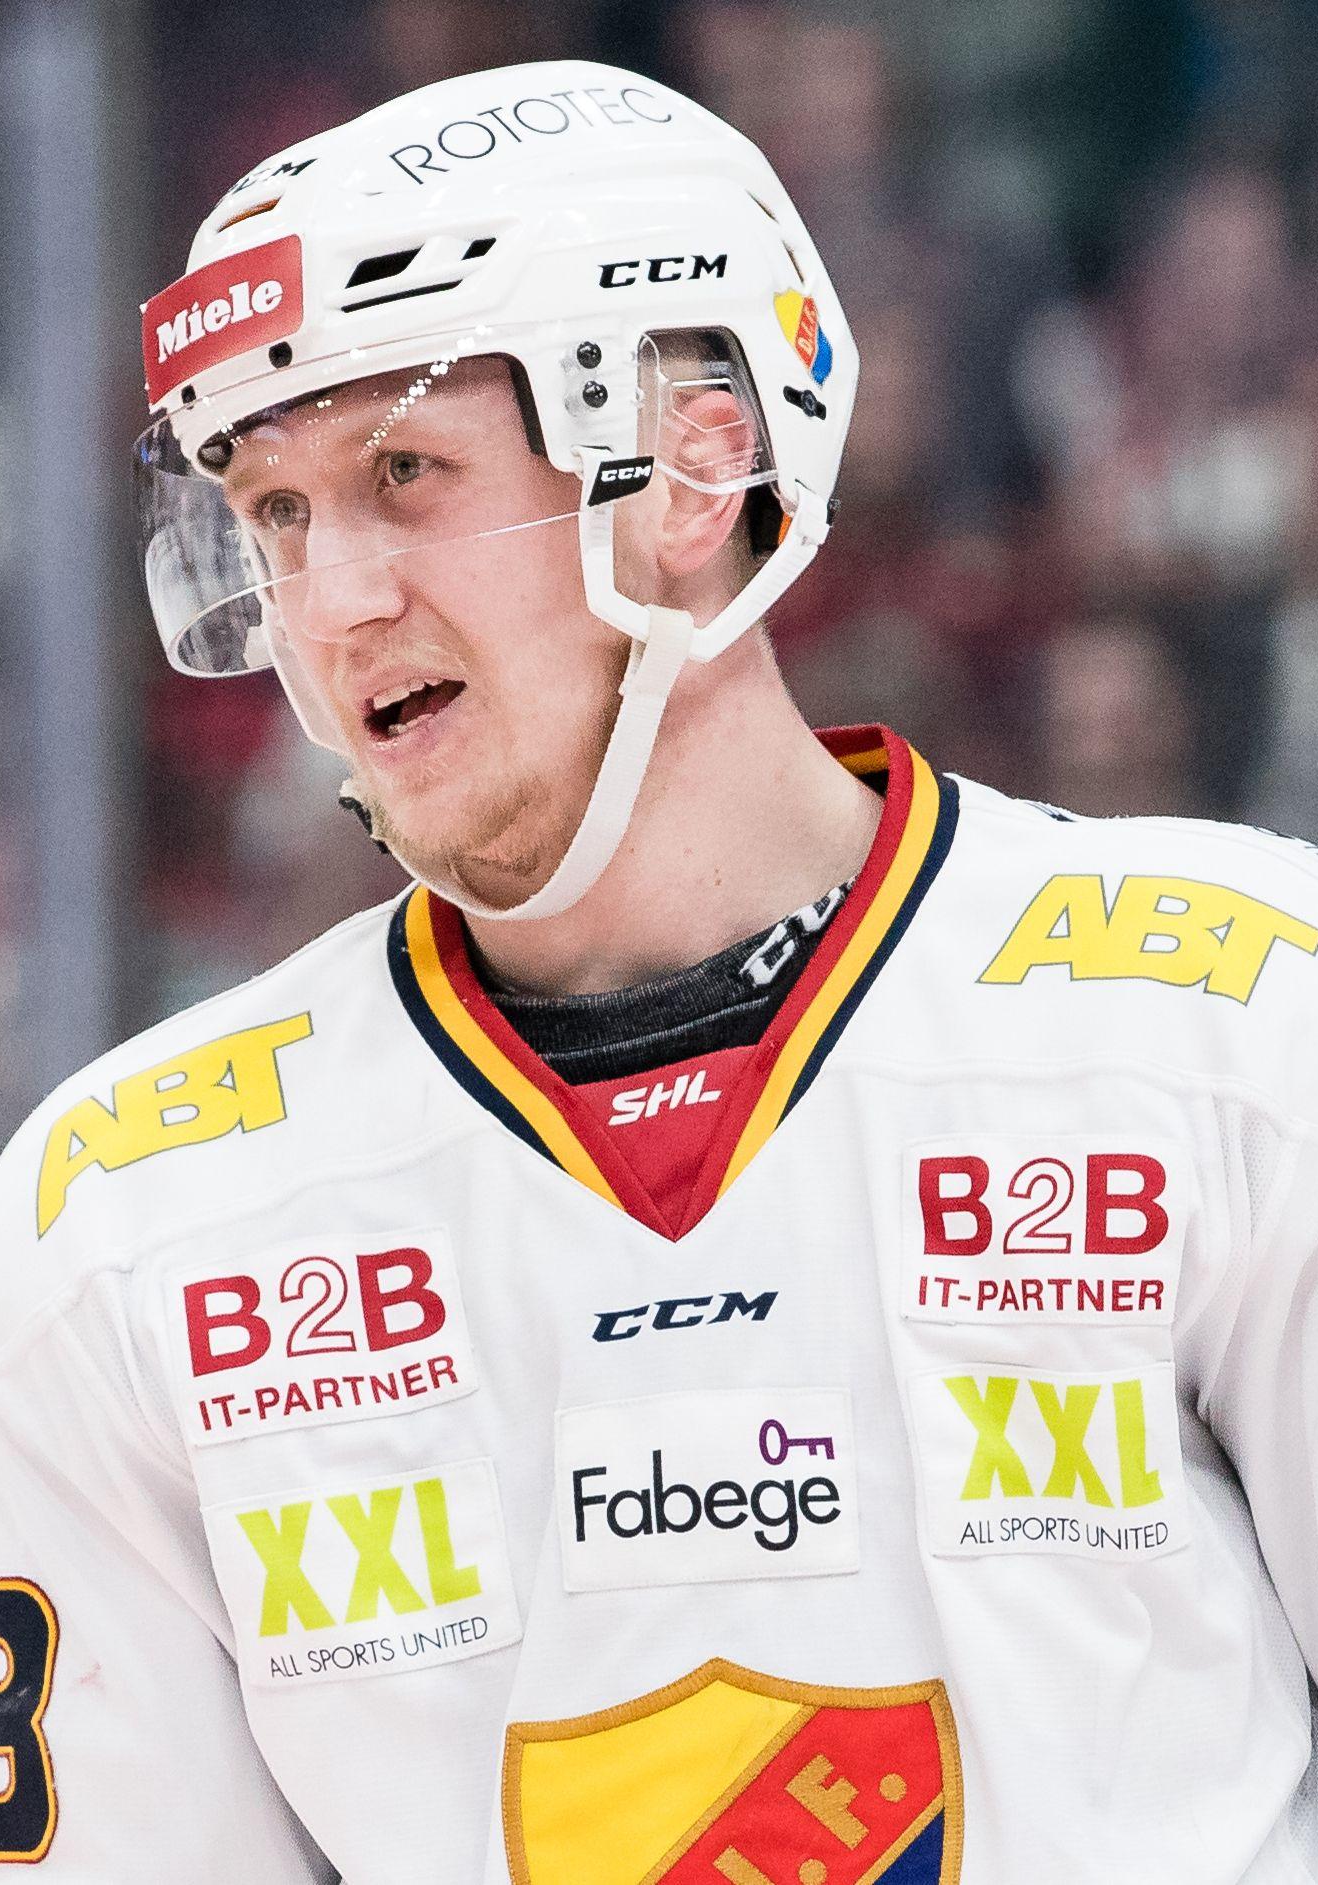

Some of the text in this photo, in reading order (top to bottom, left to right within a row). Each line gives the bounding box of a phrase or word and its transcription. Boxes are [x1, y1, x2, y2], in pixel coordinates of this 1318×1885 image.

[389, 88, 672, 185] ROTOTEC
[599, 254, 728, 289] CCM
[156, 280, 283, 364] Miele
[601, 465, 652, 482] CCM
[739, 875, 856, 988] CC
[36, 1010, 314, 1239] ABT
[608, 1070, 722, 1126] SHL
[919, 1153, 1169, 1257] B2B
[183, 1246, 448, 1378] B2B
[591, 1291, 779, 1342] CCM
[918, 1276, 1164, 1313] IT-PARTNER
[198, 1354, 459, 1432] IT-PARTNER
[943, 1375, 1164, 1508] XXL
[572, 1450, 842, 1552] Fabege
[959, 1516, 1169, 1551] ALL SPORTS UNITED
[237, 1477, 482, 1639] XXL
[269, 1615, 489, 1679] ALL SPORTS UNITED
